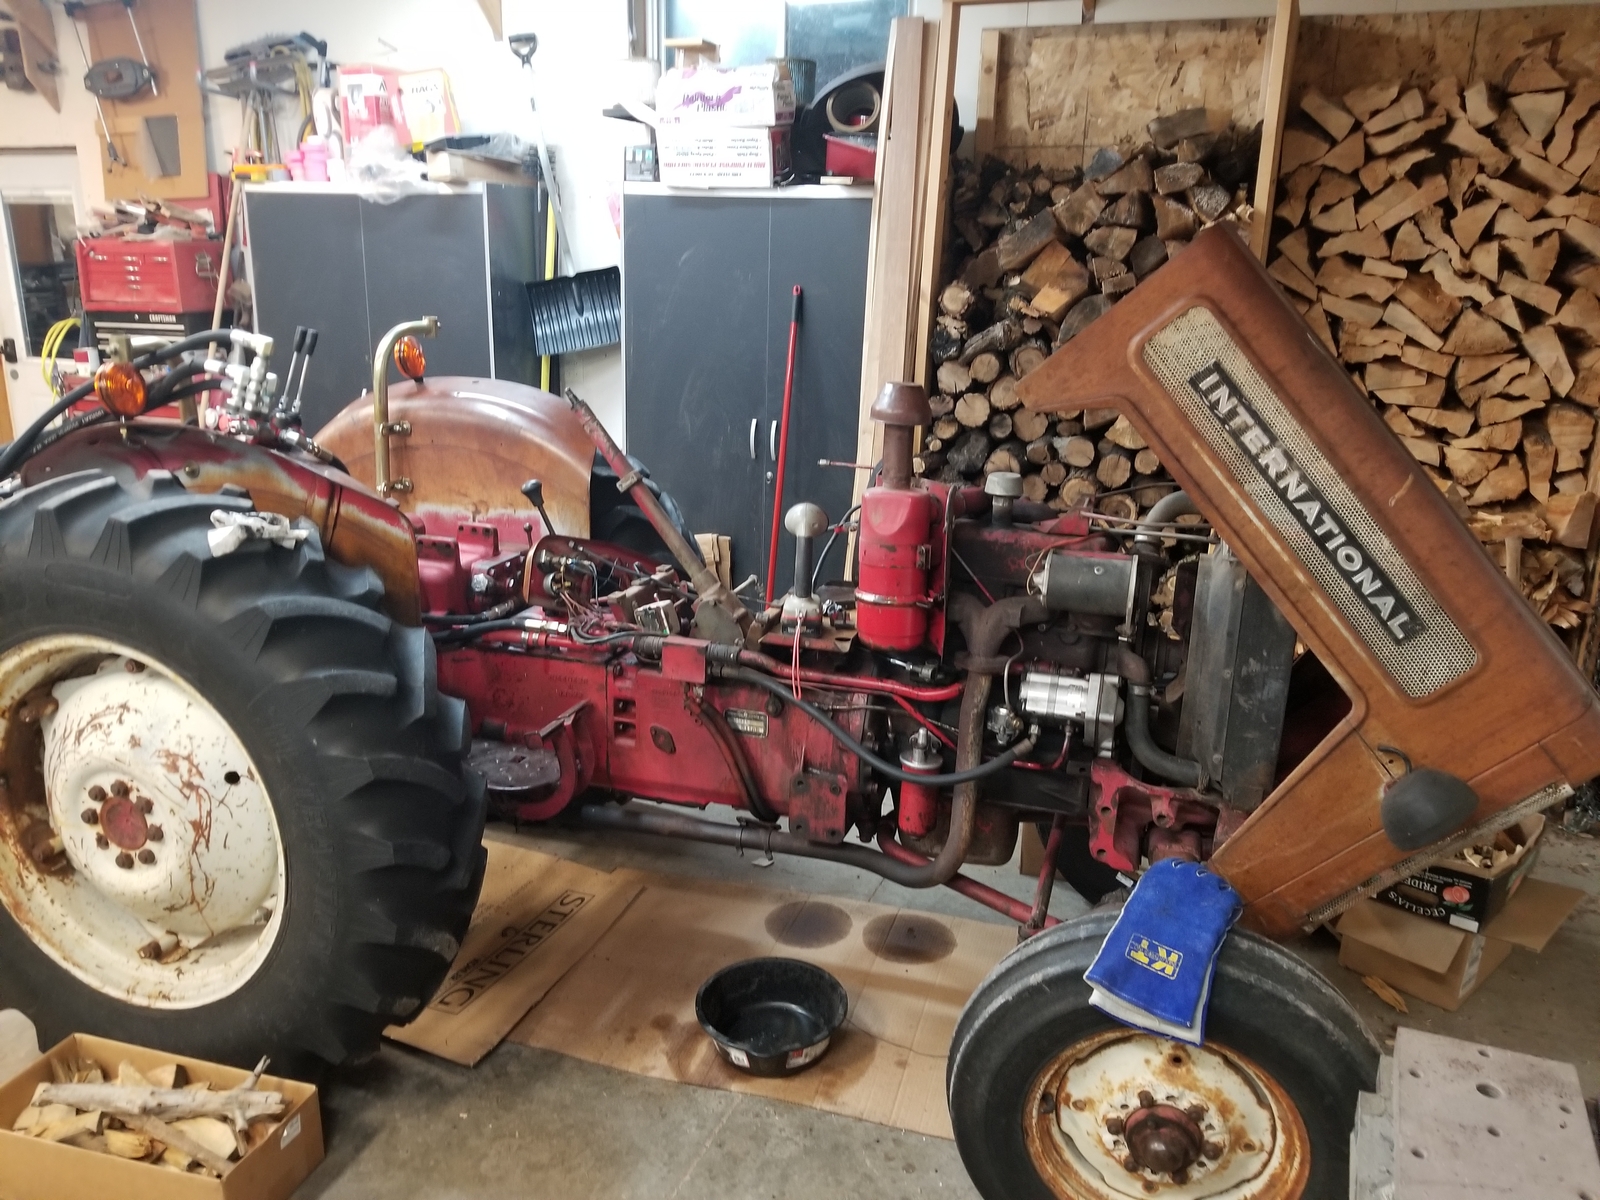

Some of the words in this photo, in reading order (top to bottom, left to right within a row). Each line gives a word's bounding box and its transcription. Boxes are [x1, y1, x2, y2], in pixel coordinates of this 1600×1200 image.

[149, 313, 177, 323] CRAFTSMAN
[1199, 371, 1412, 640] INTERNATIONAL
[1388, 890, 1446, 917] CECELIA'S
[438, 893, 586, 1007] STERLING
